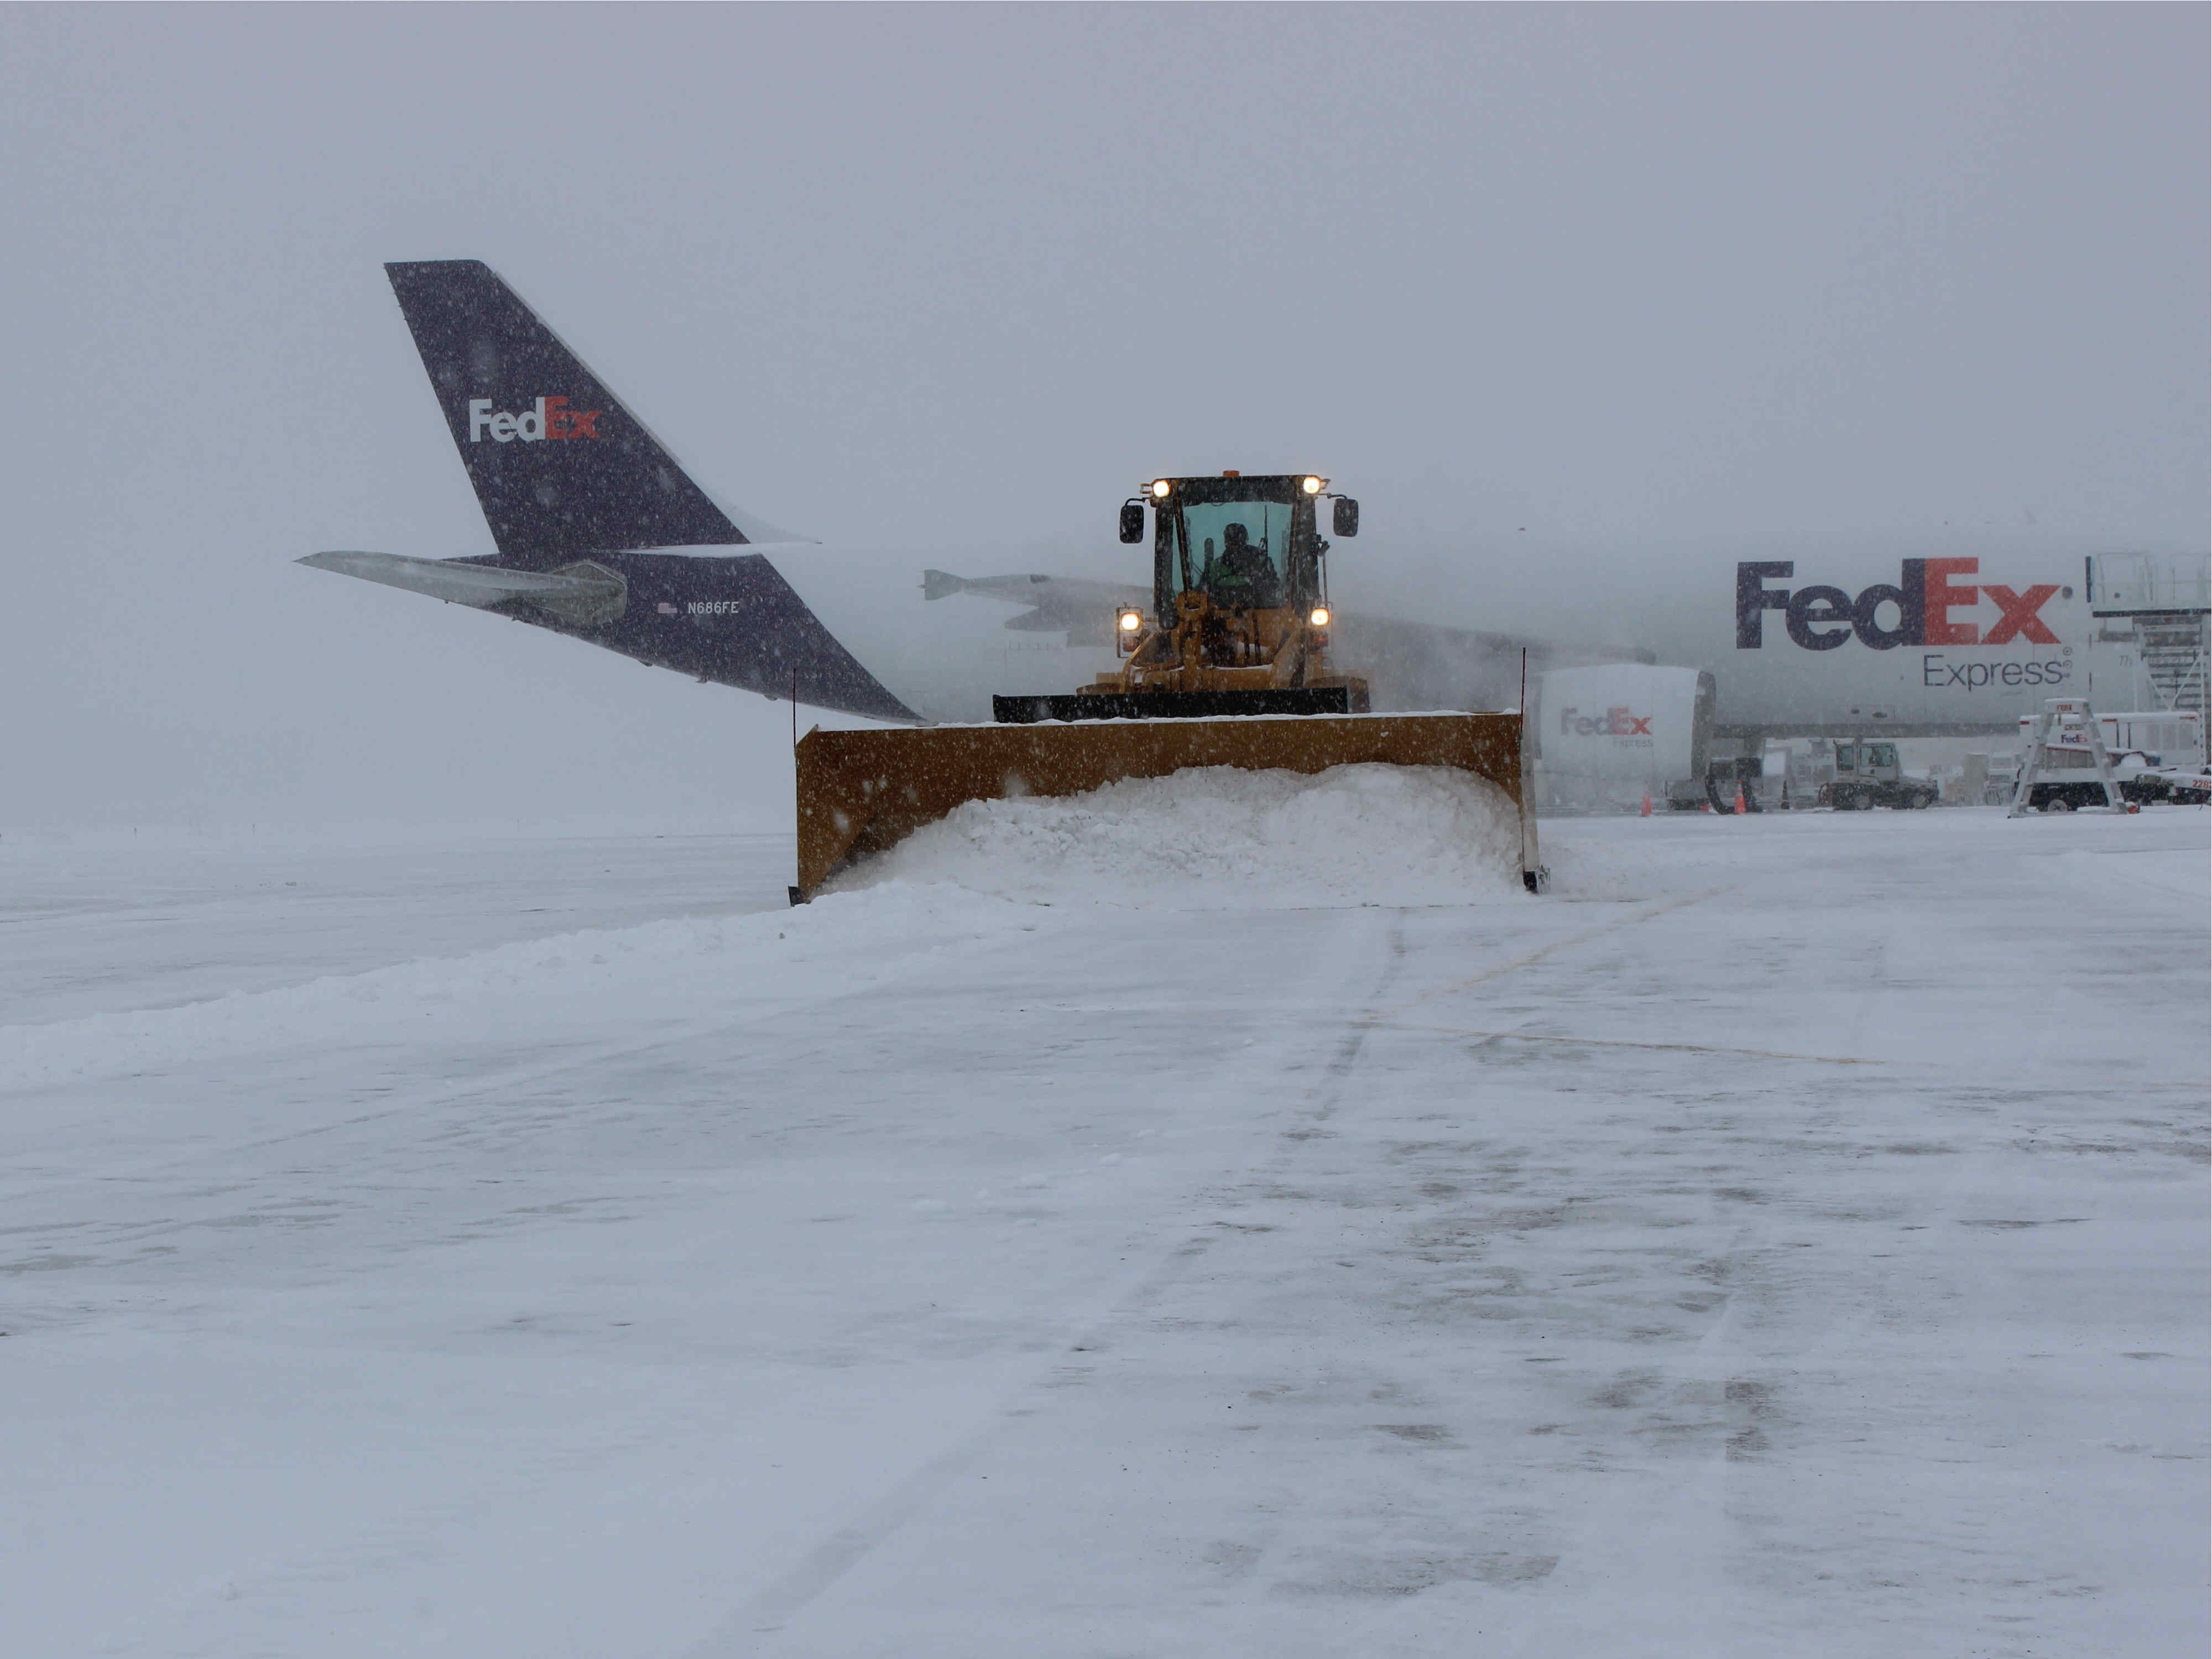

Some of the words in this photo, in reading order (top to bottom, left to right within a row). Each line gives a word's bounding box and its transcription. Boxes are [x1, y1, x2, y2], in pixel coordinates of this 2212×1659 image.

[470, 396, 601, 443] FedEx
[688, 602, 739, 615] N686FE
[1736, 557, 2062, 651] FedEx
[1924, 654, 2063, 692] Express
[1561, 707, 1653, 736] FedEx
